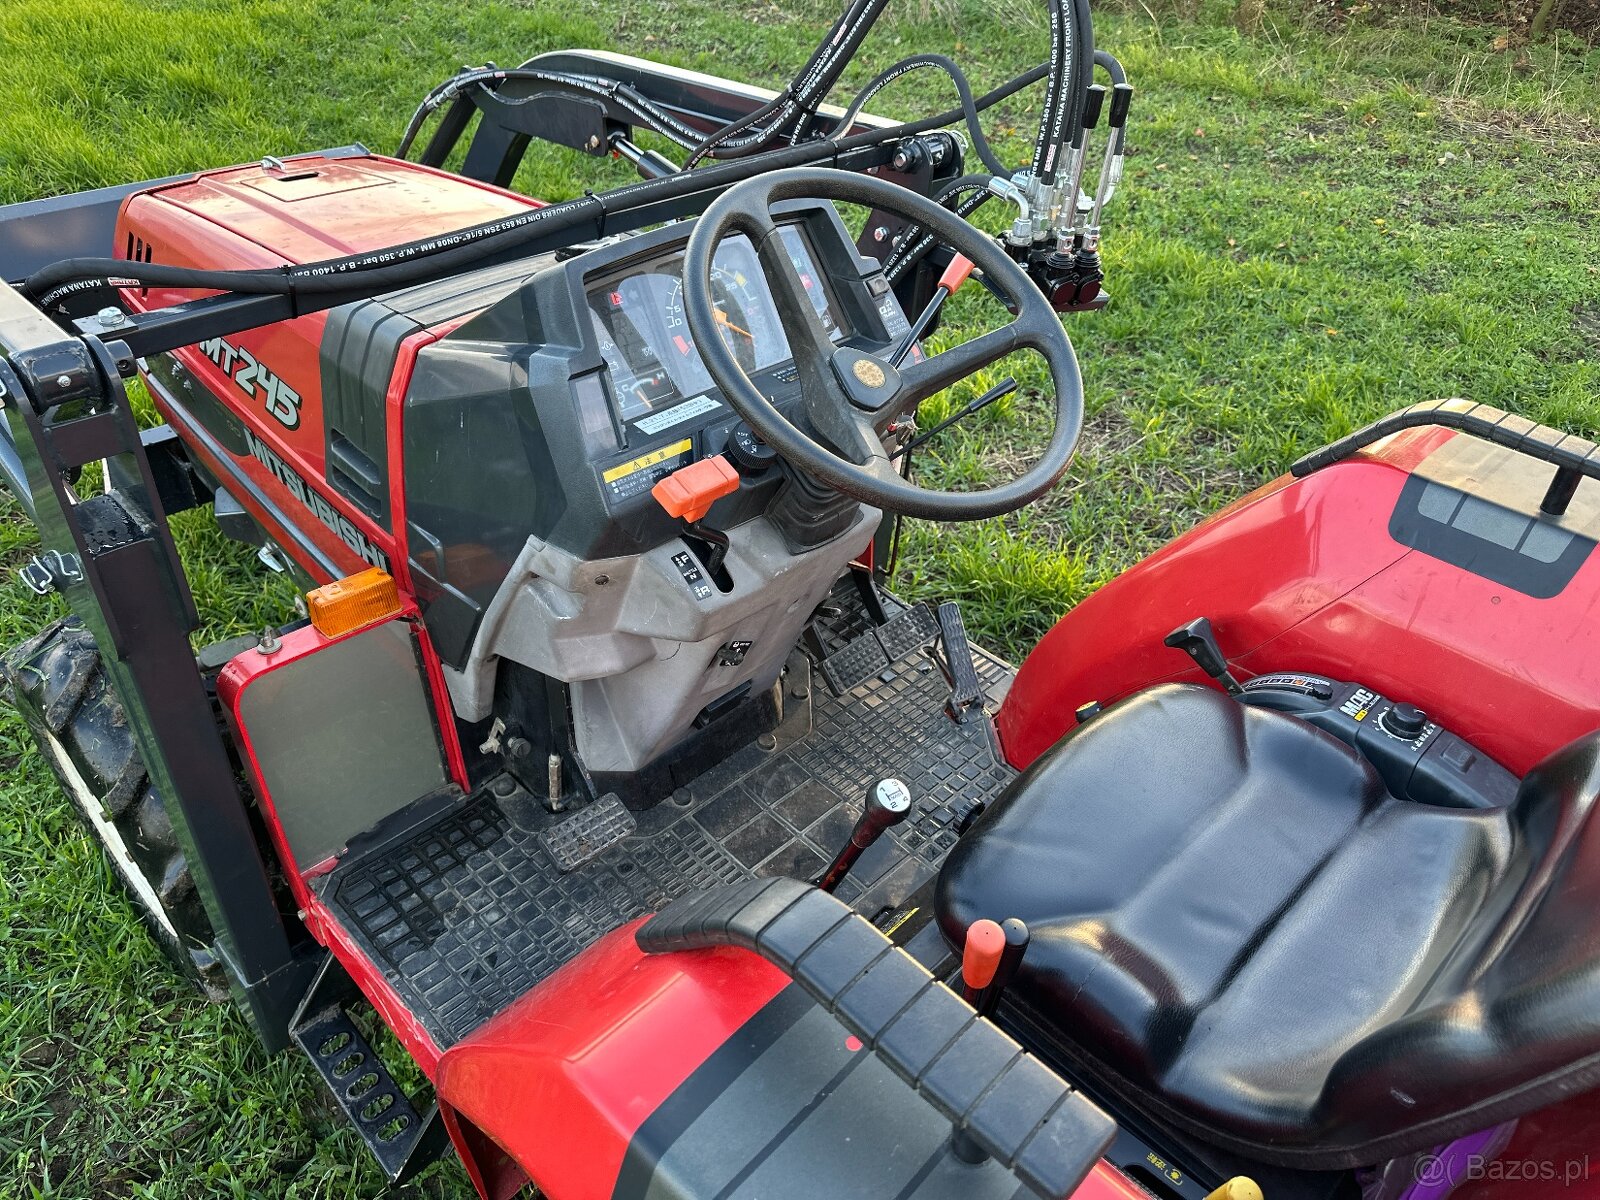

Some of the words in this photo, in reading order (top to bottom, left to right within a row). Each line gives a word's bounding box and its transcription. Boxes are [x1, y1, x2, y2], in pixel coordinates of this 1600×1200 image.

[1053, 102, 1066, 138] KATANA
[1060, 49, 1072, 100] MACHINERY
[1039, 124, 1047, 140] W.P.
[516, 218, 526, 226] EN
[527, 214, 540, 223] DIN
[502, 220, 515, 230] 853
[484, 226, 500, 235] 2SN
[420, 242, 436, 252] MM
[379, 254, 395, 262] 350
[396, 248, 415, 258] W.P.
[363, 256, 378, 265] bar
[312, 266, 334, 276] 1400
[338, 261, 356, 271] B.P.
[68, 279, 102, 292] KATANA
[200, 338, 302, 430] MT245
[244, 427, 390, 573] MITSUBISHI
[680, 554, 688, 563] F
[700, 586, 710, 595] R
[1339, 688, 1373, 717] MAC
[890, 801, 898, 809] 2
